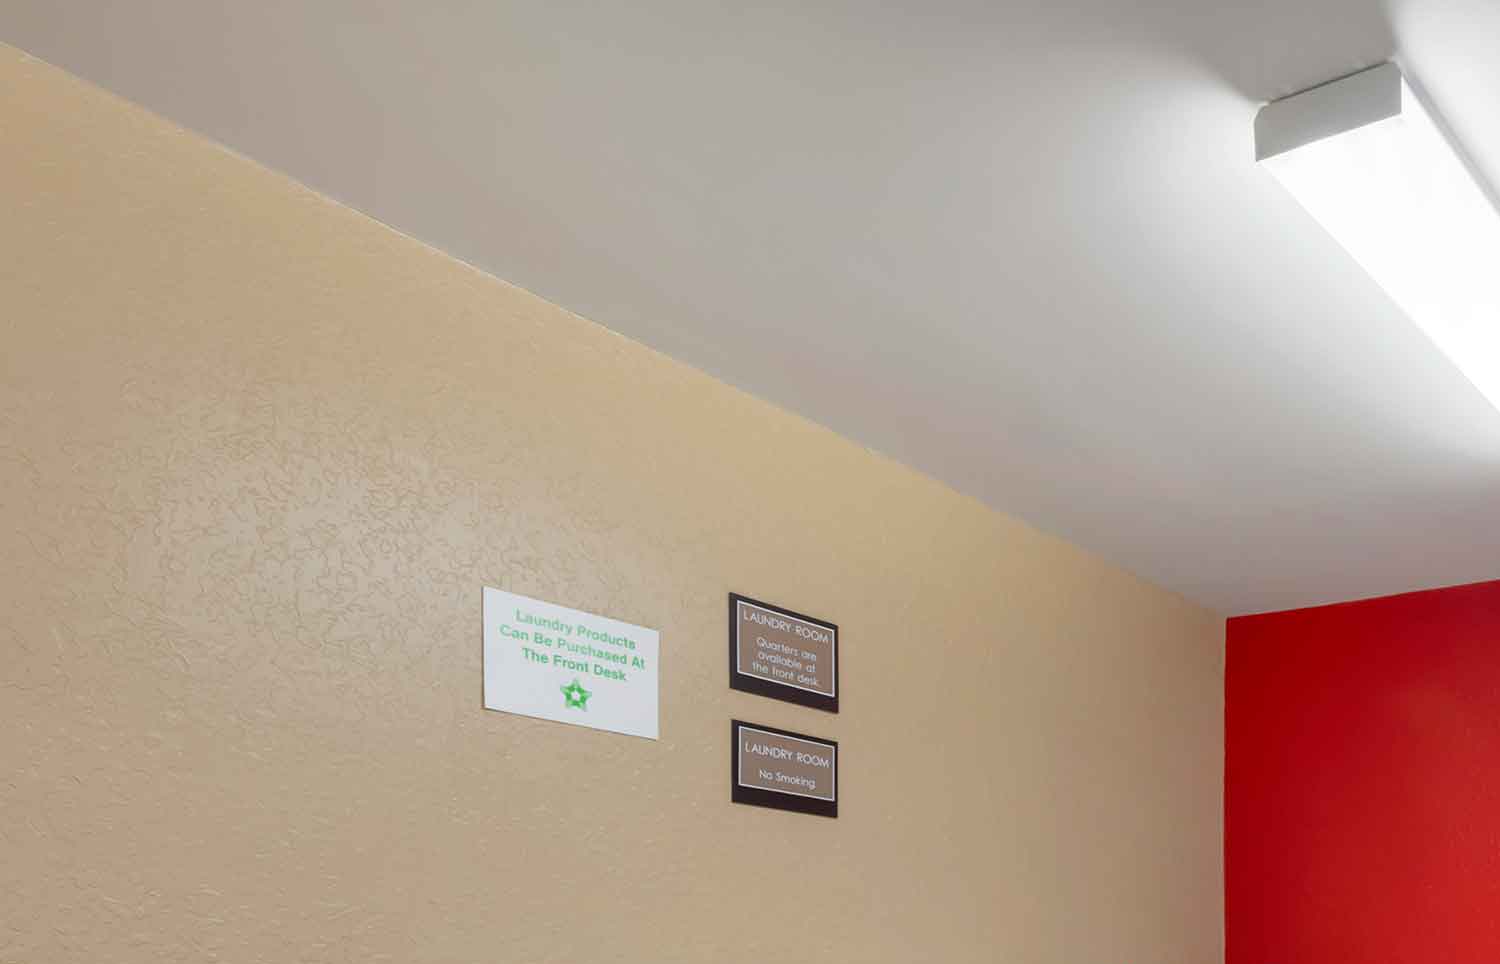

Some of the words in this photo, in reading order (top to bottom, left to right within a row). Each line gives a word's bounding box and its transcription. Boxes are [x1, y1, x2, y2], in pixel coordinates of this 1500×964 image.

[515, 609, 573, 634] Laundry
[576, 625, 636, 649] Products
[743, 607, 793, 632] LAUNDRY
[795, 625, 830, 644] ROOM
[500, 624, 529, 641] Can
[533, 632, 553, 646] Be
[557, 638, 627, 665] Purchased
[632, 656, 645, 669] At
[756, 637, 799, 656] Quarters
[800, 650, 817, 661] are
[522, 647, 549, 663] The
[553, 655, 589, 673] Front
[593, 664, 627, 681] Desk
[752, 661, 769, 673] the
[772, 666, 794, 681] front
[758, 651, 802, 669] available
[806, 664, 816, 673] at
[744, 741, 793, 760] LAUNDRY
[796, 752, 830, 769] ROOM
[759, 769, 774, 781] No
[775, 772, 816, 790] Smoking
